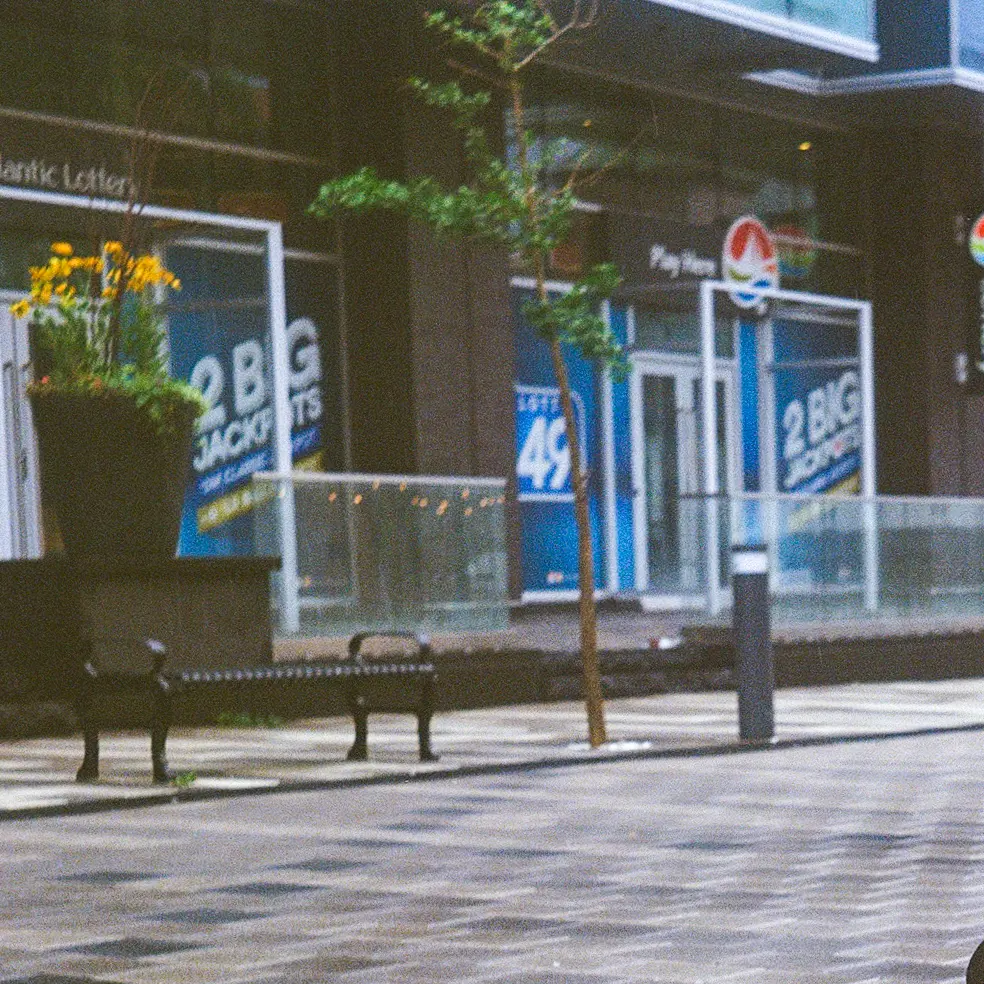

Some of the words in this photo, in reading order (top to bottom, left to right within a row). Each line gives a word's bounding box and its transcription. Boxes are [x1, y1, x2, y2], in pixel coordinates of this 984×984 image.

[190, 354, 228, 432] 2
[232, 317, 323, 418] BG
[783, 399, 805, 460] 2
[807, 371, 862, 444] BIG
[192, 385, 323, 473] JACKPTS
[516, 415, 571, 489] 49
